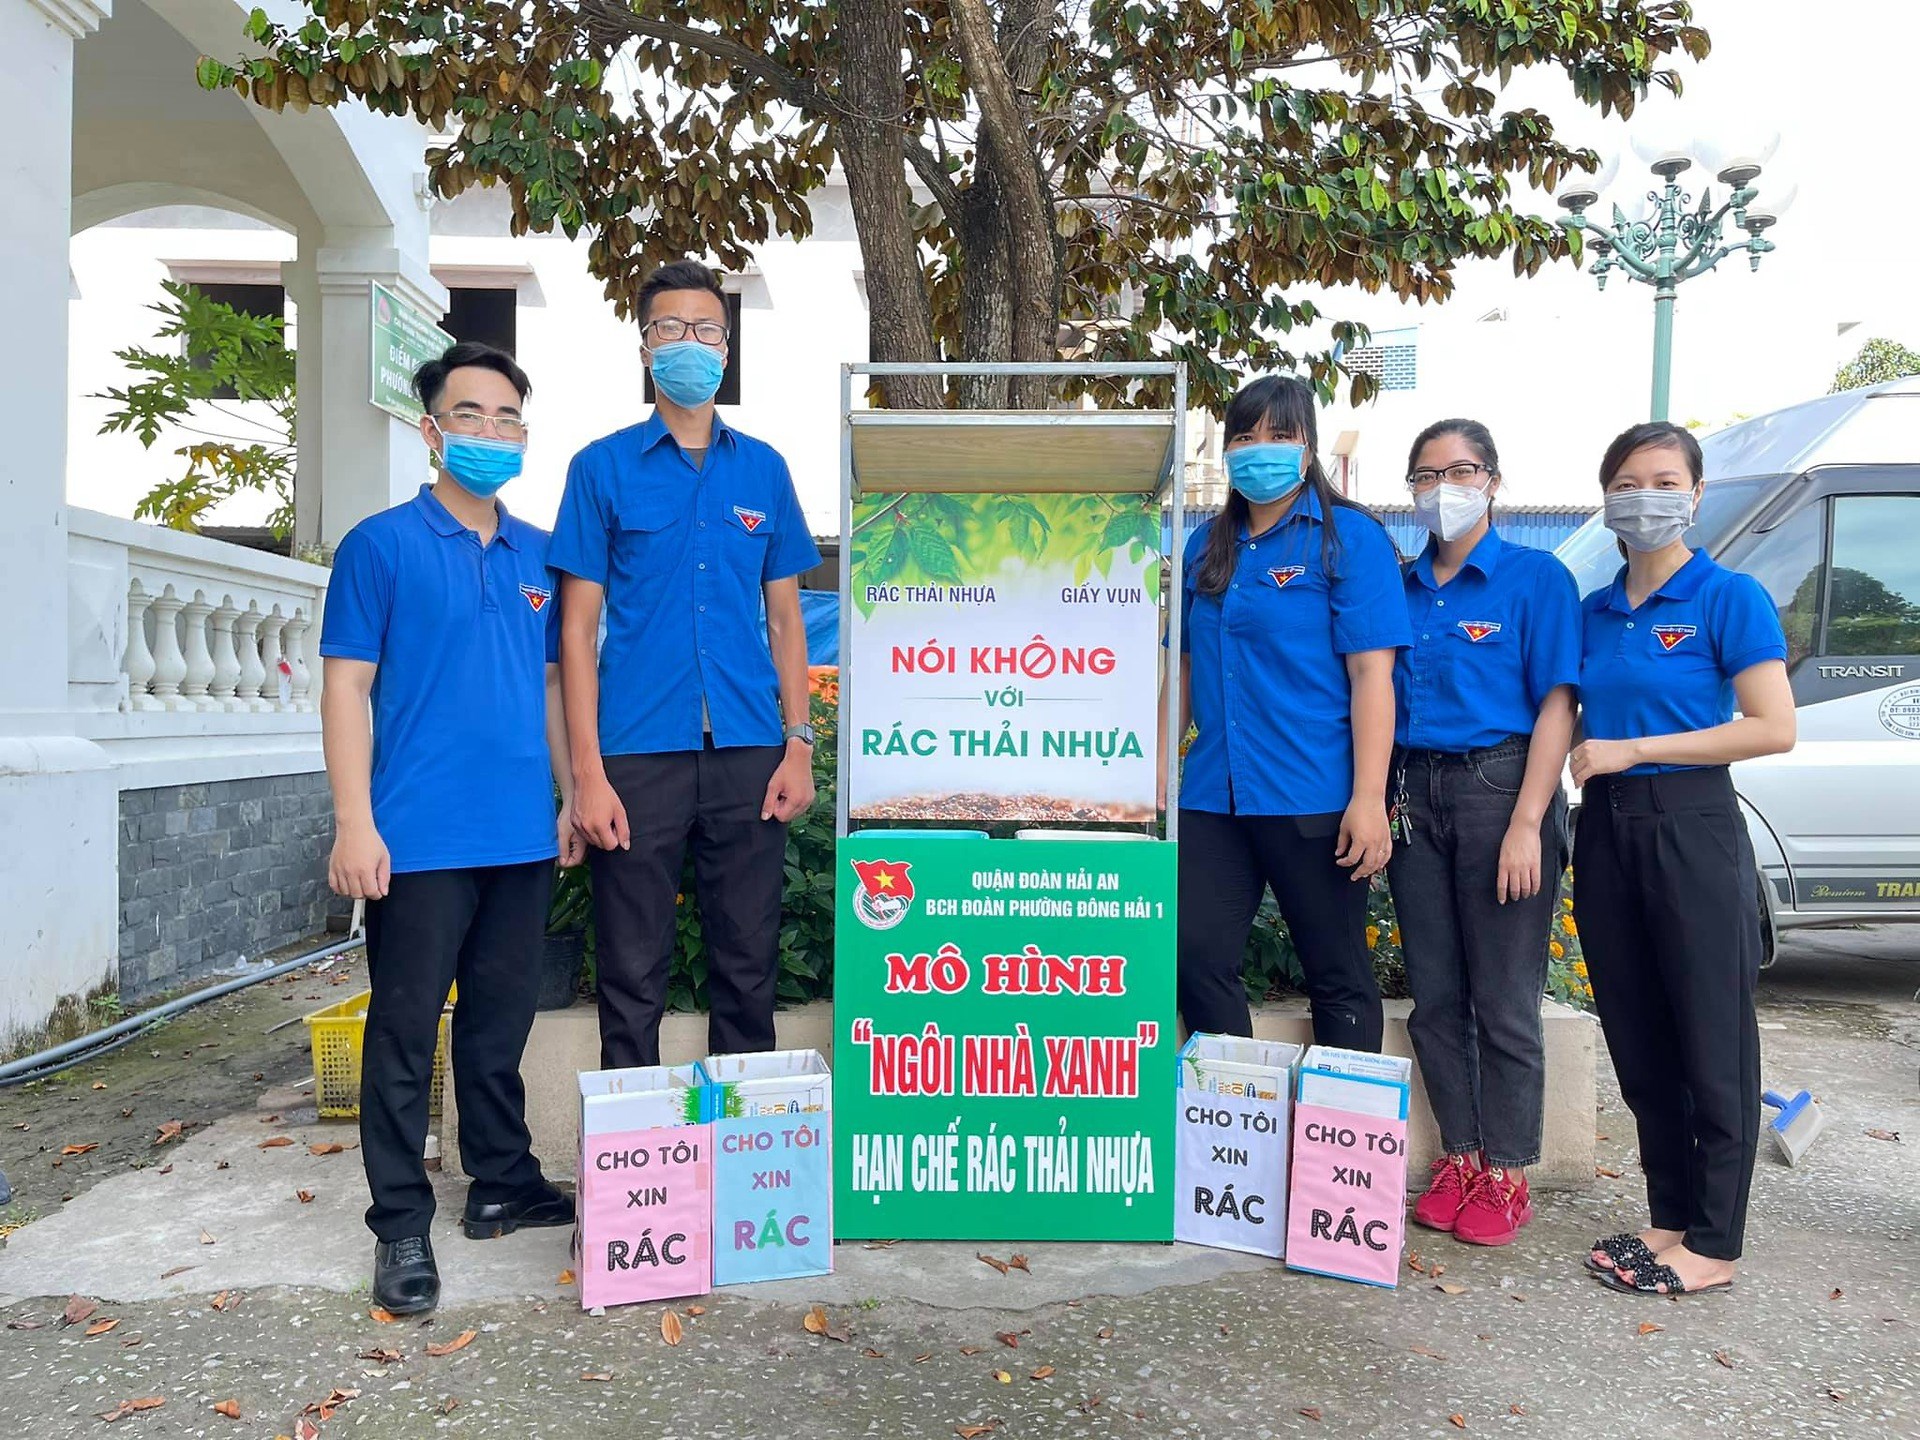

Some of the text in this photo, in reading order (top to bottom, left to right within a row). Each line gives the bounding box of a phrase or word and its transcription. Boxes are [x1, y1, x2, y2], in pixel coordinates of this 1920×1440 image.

[866, 582, 996, 606] RÁC THẢI NHỰA
[1062, 581, 1141, 606] GIẤY VỤN
[893, 635, 1115, 678] NÓI KHÔNG
[1818, 665, 1905, 677] TRANSIT
[985, 686, 1023, 706] VỚI
[863, 720, 1143, 766] RÁC THẢI NHỰA
[972, 868, 1119, 892] QUẬN ĐOÀN HẢI AN
[926, 899, 957, 915] BCH
[961, 896, 1005, 916] ĐOÀN
[1009, 896, 1073, 917] PHƯỜNG
[1077, 897, 1120, 918] ĐÔNG
[1124, 896, 1151, 918] HẢI
[1155, 902, 1164, 919] 1
[884, 942, 1127, 996] MÔ HÌNH
[962, 1023, 1037, 1097] NHÀ
[1186, 1106, 1276, 1134] CHO TÔI
[723, 1124, 819, 1152] CHO TÔI
[1305, 1124, 1404, 1156] CHO TÔI
[597, 1140, 698, 1171] CHO TÔI
[852, 1116, 1154, 1206] HẠN CHẾ RÁC THẢI NHỰA
[1212, 1146, 1247, 1166] XIN
[753, 1170, 790, 1189] XIN
[1332, 1166, 1371, 1189] XIN
[627, 1187, 666, 1208] XIN
[1195, 1184, 1264, 1224] RÁC
[734, 1209, 810, 1250] RÁC
[1311, 1207, 1388, 1251] RÁC
[608, 1228, 686, 1271] RÁC
